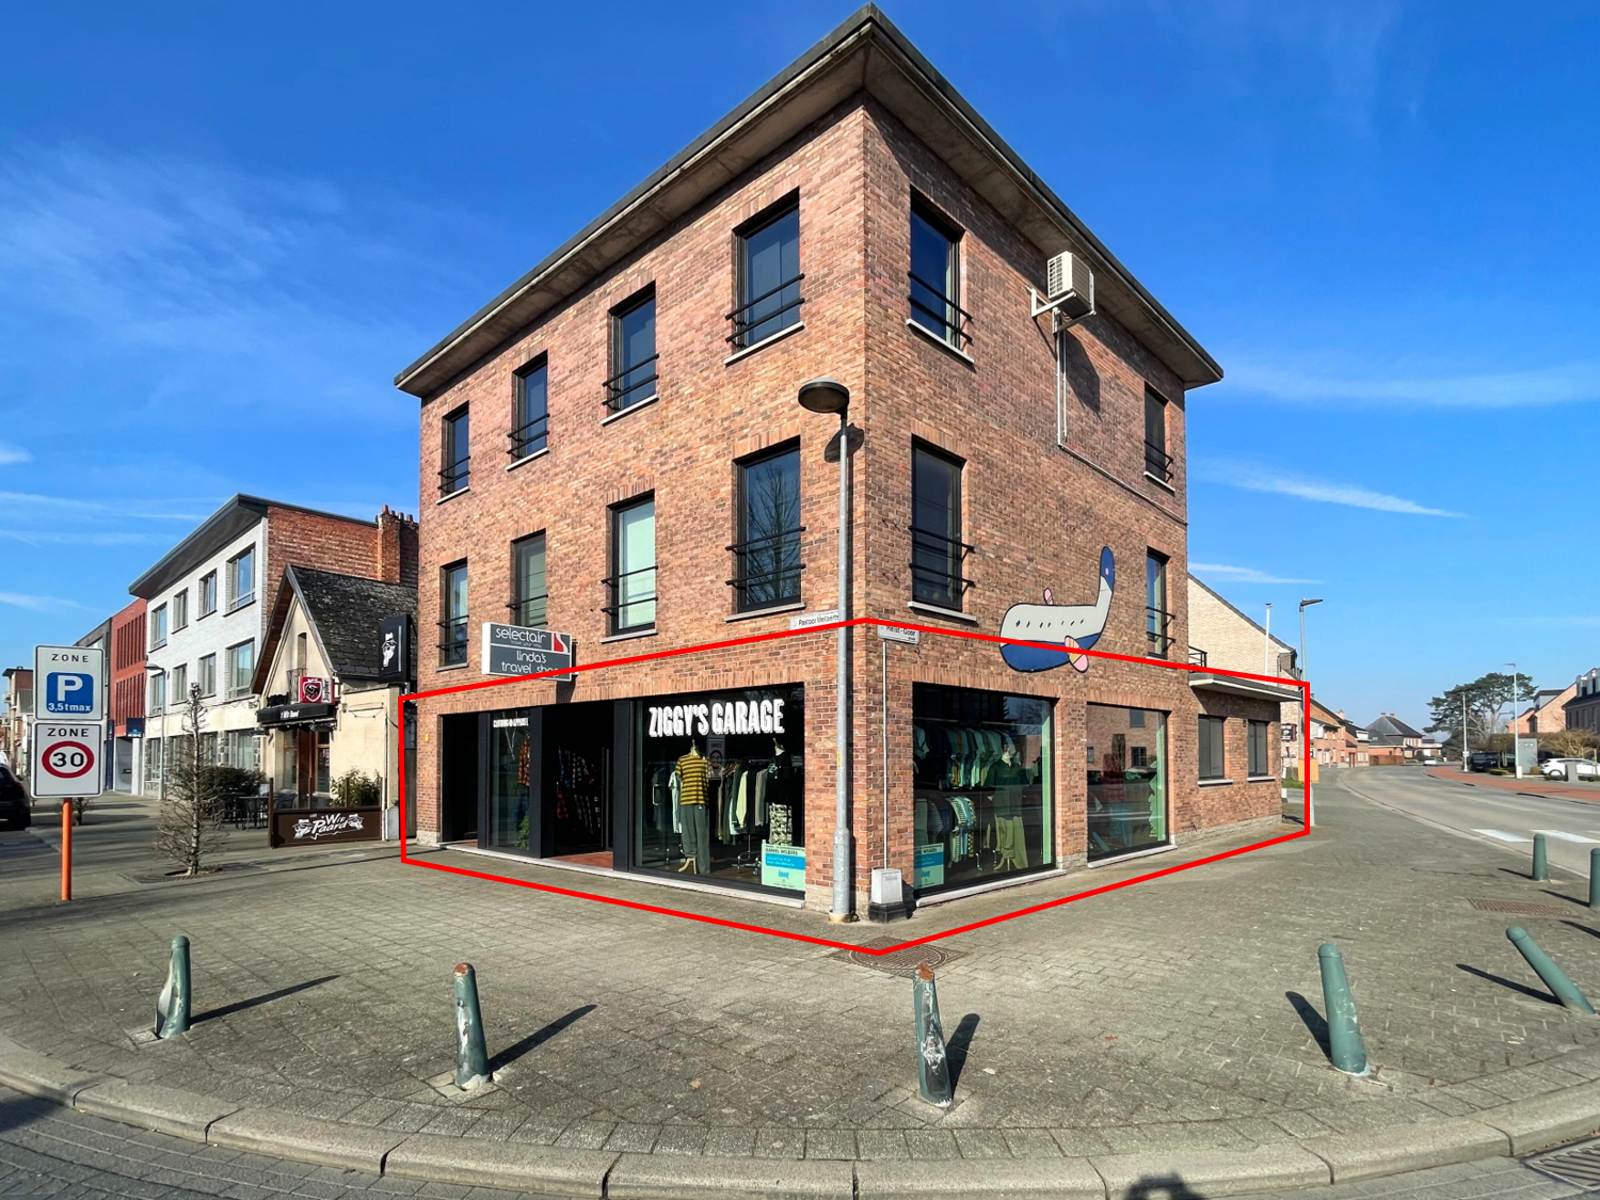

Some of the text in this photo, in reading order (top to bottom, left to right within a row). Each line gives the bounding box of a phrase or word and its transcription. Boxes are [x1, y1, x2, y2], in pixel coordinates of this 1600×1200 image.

[799, 618, 816, 626] Pastoor
[495, 627, 546, 643] selectair
[51, 653, 89, 663] ZONE
[516, 650, 547, 664] linda's
[501, 661, 532, 673] travel
[57, 674, 83, 702] P
[648, 698, 785, 737] ZIGGY'S GARAGE
[47, 727, 89, 737] ZONE
[52, 752, 85, 767] 30
[311, 819, 348, 834] Paard
